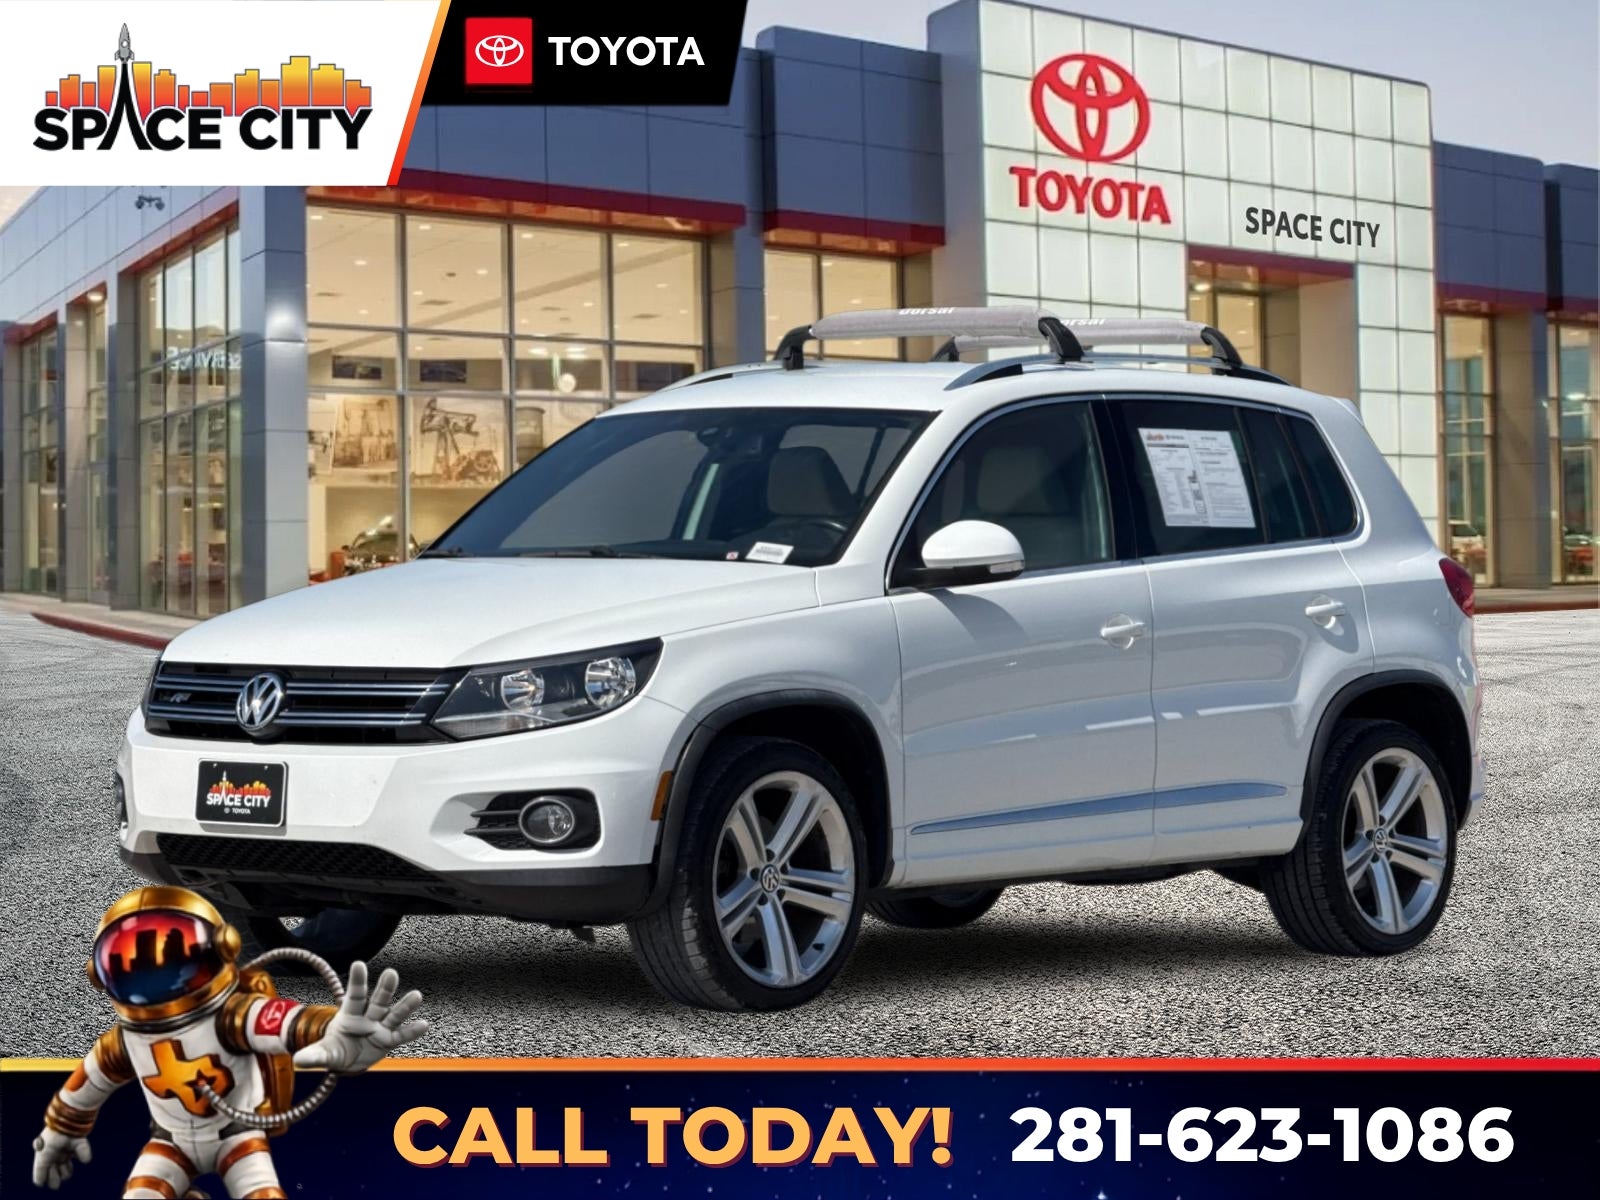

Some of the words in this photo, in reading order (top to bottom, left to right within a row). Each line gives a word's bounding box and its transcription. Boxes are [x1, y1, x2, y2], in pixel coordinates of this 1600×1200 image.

[1009, 165, 1171, 224] TOYOTA
[1245, 206, 1323, 242] SPACE
[1329, 217, 1381, 248] CITY
[206, 788, 242, 806] SPACE
[243, 794, 272, 808] CITY
